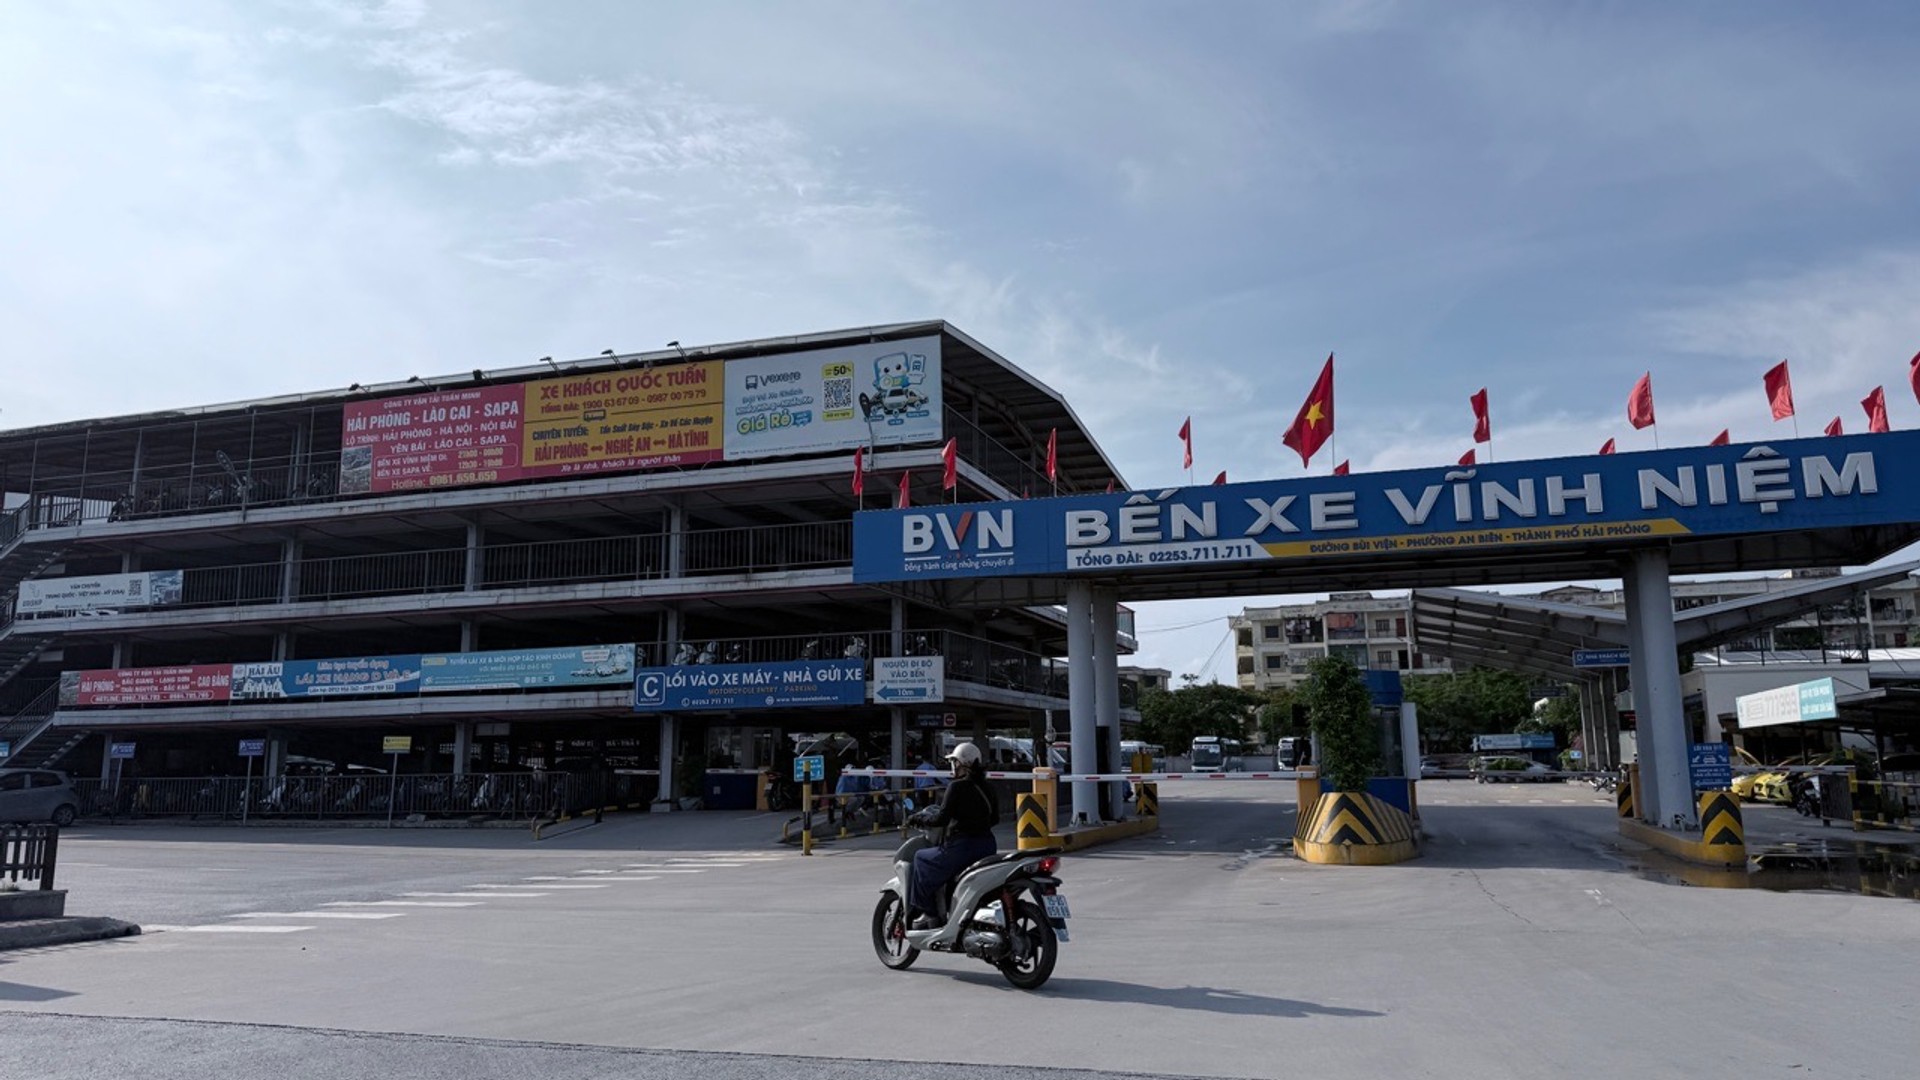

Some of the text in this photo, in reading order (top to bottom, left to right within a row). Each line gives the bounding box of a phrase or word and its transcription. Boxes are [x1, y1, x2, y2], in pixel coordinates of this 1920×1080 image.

[541, 363, 706, 400] XE KHÁCH QUỐC TUẤN
[404, 399, 411, 407] TY
[582, 399, 602, 409] 1900
[628, 396, 639, 405] 09
[670, 391, 682, 400] 00
[683, 390, 694, 399] 79
[695, 389, 706, 399] 79
[347, 400, 519, 432] HẢI PHÒNG LÀO CAI SAPA
[383, 429, 398, 441] HẢI
[401, 428, 432, 440] PHÒNG
[440, 424, 453, 435] HÀ
[456, 422, 472, 435] NỘI
[480, 420, 497, 434] NỘI
[391, 443, 407, 454] YÊN
[434, 437, 453, 449] LÀO
[455, 438, 472, 447] CAI
[480, 435, 507, 446] SAPA
[534, 429, 709, 462] HẢI PHÒNG NGHỆ AN HÀ TĨNH
[392, 457, 400, 466] XE
[392, 467, 400, 475] XE
[602, 459, 626, 468] khách
[637, 456, 661, 467] người
[391, 479, 426, 490] Hotline:
[1065, 445, 1878, 546] BẾN XE VĨNH NIỆM
[903, 508, 1014, 554] BVN
[1310, 521, 1651, 554] ĐƯỜNG BÙI VIỆN PHƯỜNG AN BIÊN THÀNH PHỐ HẢI PHÒNG
[923, 560, 940, 570] hành
[1076, 545, 1252, 567] TỔNG ĐÀI: 02253.711.711
[249, 663, 281, 675] HẢI ÂU
[882, 659, 933, 669] NGƯỜI ĐI BỘ
[890, 668, 925, 678] VÀO BẾN
[197, 675, 211, 687] CAO
[666, 664, 862, 688] LỐI VÀO XE MÁY NHÀ GỬI XE
[643, 676, 659, 697] C
[898, 688, 915, 696] 10m
